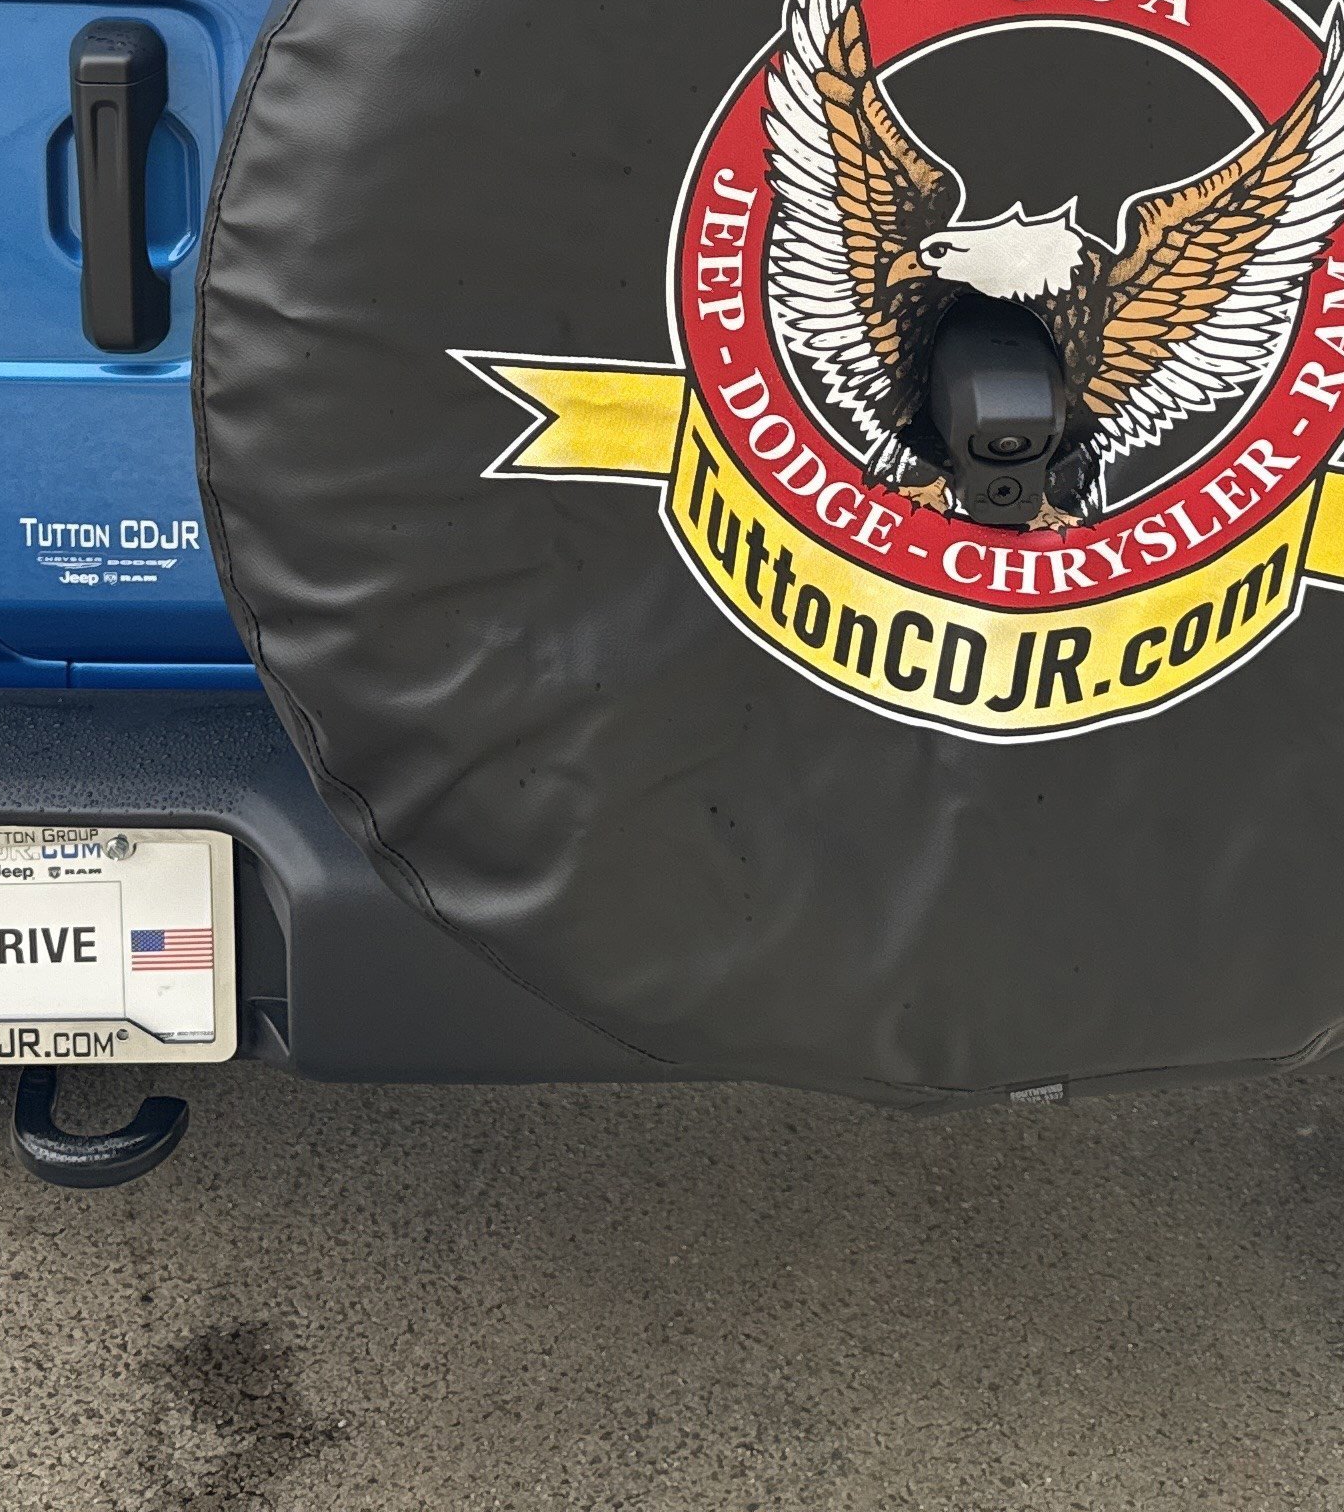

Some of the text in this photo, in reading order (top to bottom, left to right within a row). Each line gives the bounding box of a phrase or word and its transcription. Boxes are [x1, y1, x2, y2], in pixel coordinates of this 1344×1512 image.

[697, 168, 758, 331] JEEP
[120, 519, 200, 550] CDJR
[718, 367, 903, 555] DODGE
[942, 437, 1301, 595] CHRYSLER
[59, 571, 157, 586] Jeep RAM
[688, 425, 1290, 713] TuttonCDJR.com
